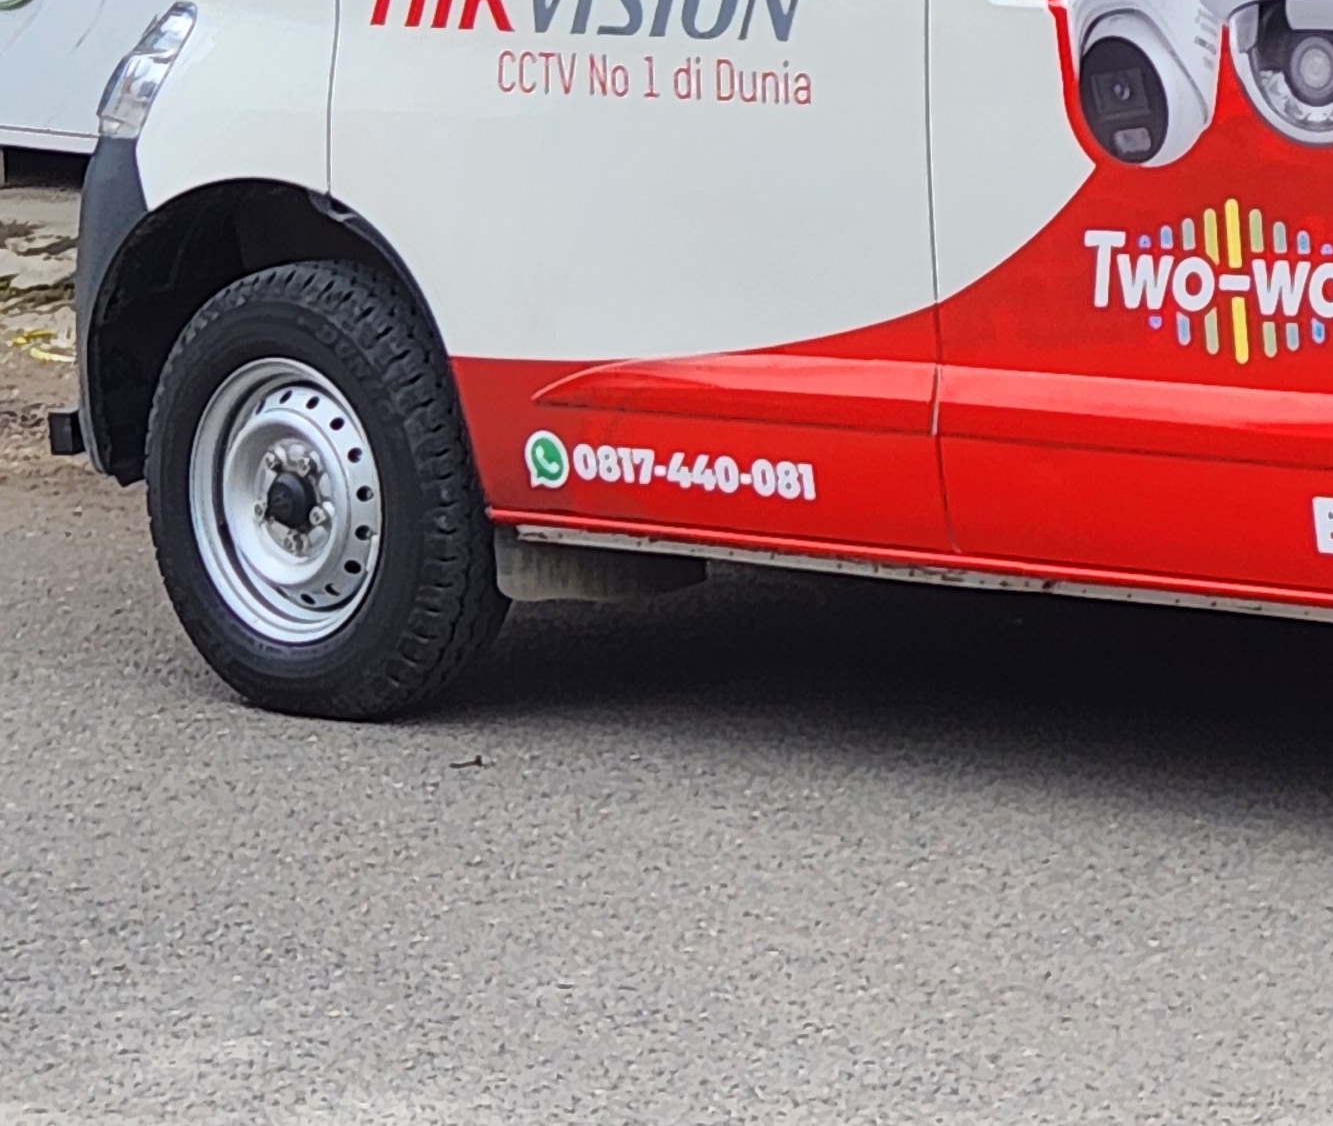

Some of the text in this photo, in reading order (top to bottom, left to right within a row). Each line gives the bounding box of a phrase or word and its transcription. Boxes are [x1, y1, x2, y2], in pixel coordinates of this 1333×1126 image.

[497, 49, 812, 105] CCTV No 1 di Dunia
[572, 442, 817, 502] 0817-440-081
